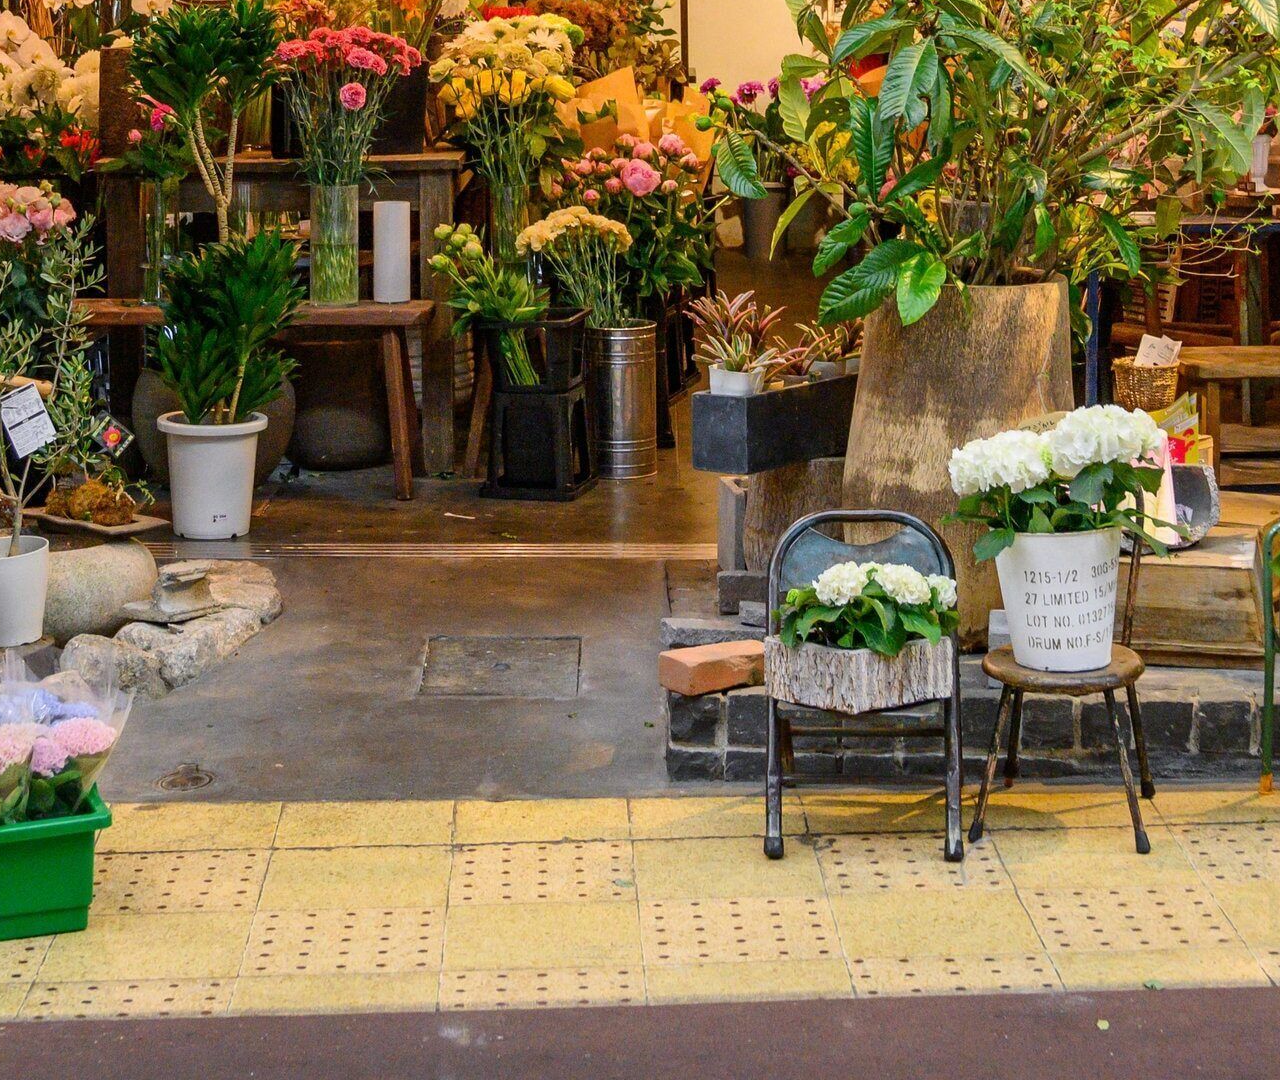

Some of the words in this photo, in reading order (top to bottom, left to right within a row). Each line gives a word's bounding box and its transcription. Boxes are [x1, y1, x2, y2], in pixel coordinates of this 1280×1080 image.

[1023, 569, 1079, 585] 1215-1/2
[1024, 592, 1038, 606] 27
[1042, 590, 1089, 607] LIMITED
[1026, 613, 1048, 628] LOT
[1027, 635, 1062, 651] DRUM
